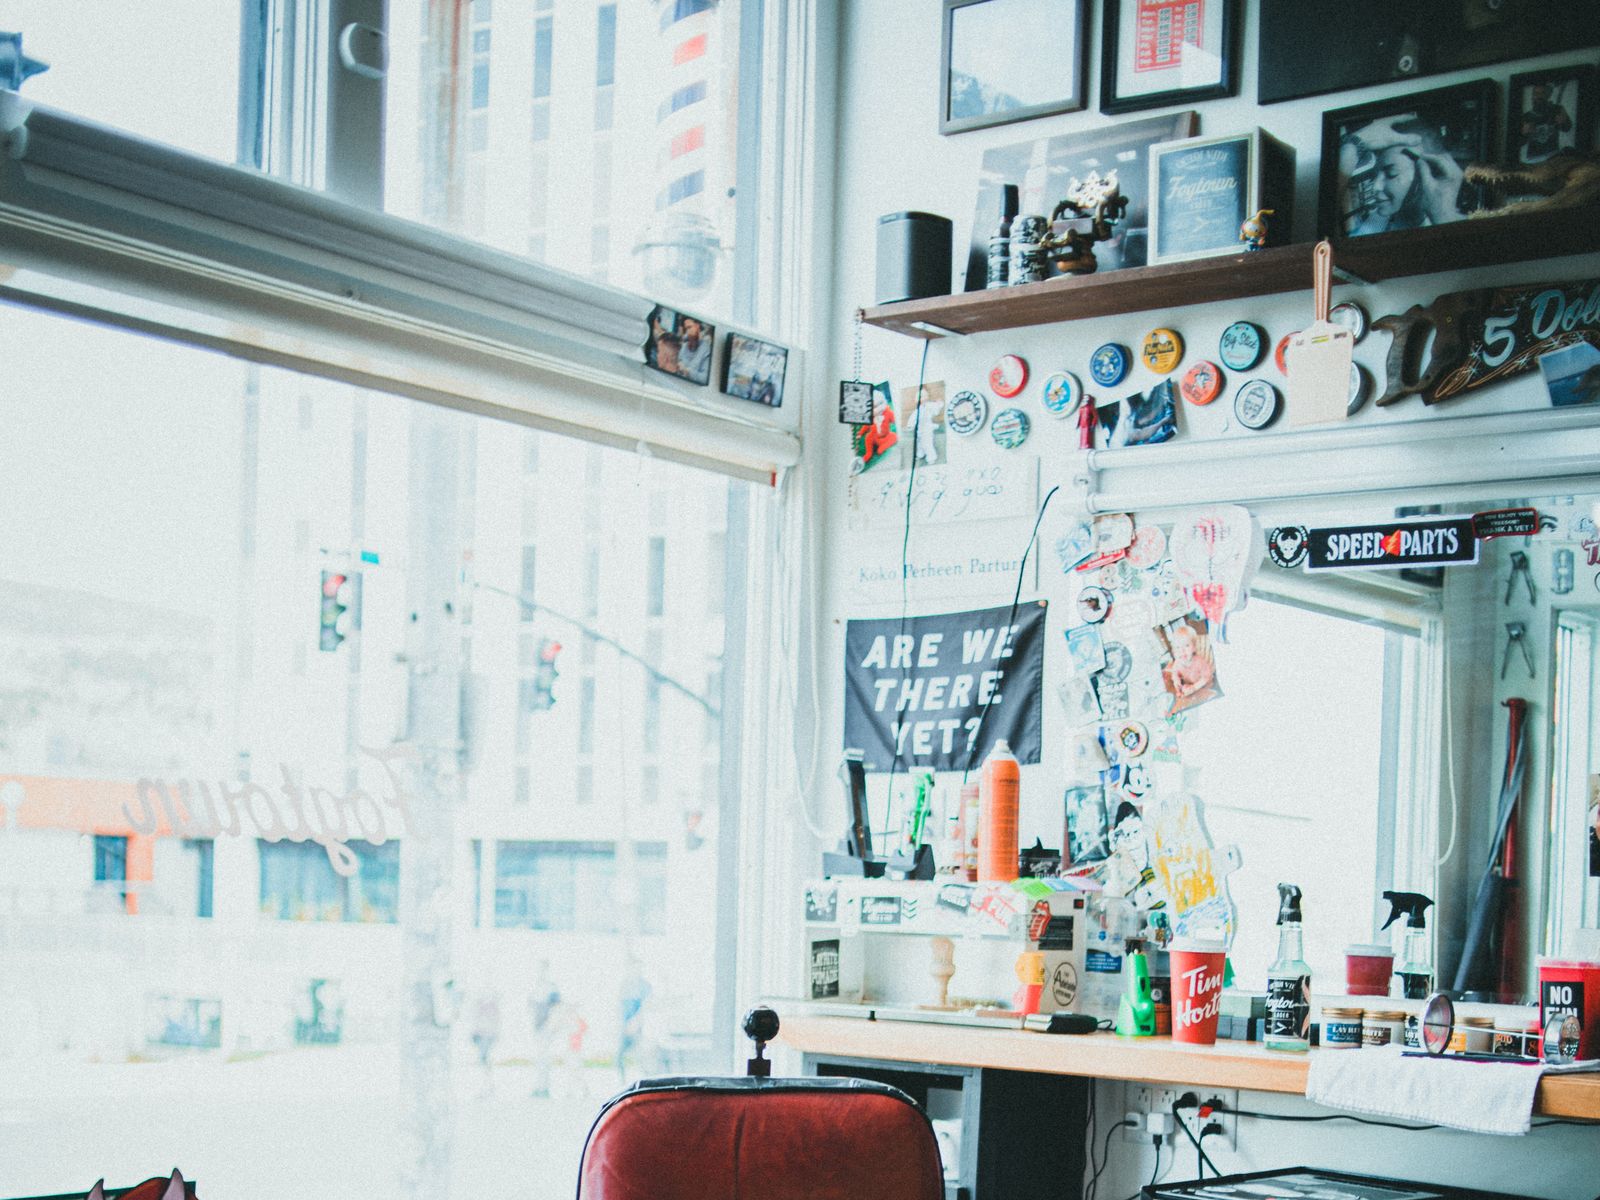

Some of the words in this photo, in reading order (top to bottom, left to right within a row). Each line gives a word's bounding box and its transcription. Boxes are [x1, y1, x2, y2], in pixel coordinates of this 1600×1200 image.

[1482, 312, 1518, 367] 5
[1326, 533, 1384, 561] SPEED
[1400, 528, 1458, 557] PARTS
[859, 567, 897, 583] Koko
[903, 559, 963, 580] Perheen
[861, 633, 943, 669] ARE
[962, 625, 1020, 665] WE
[874, 670, 1004, 712] THERE
[890, 717, 982, 756] YET?
[1182, 965, 1222, 998] Tim
[1550, 986, 1573, 1005] NO
